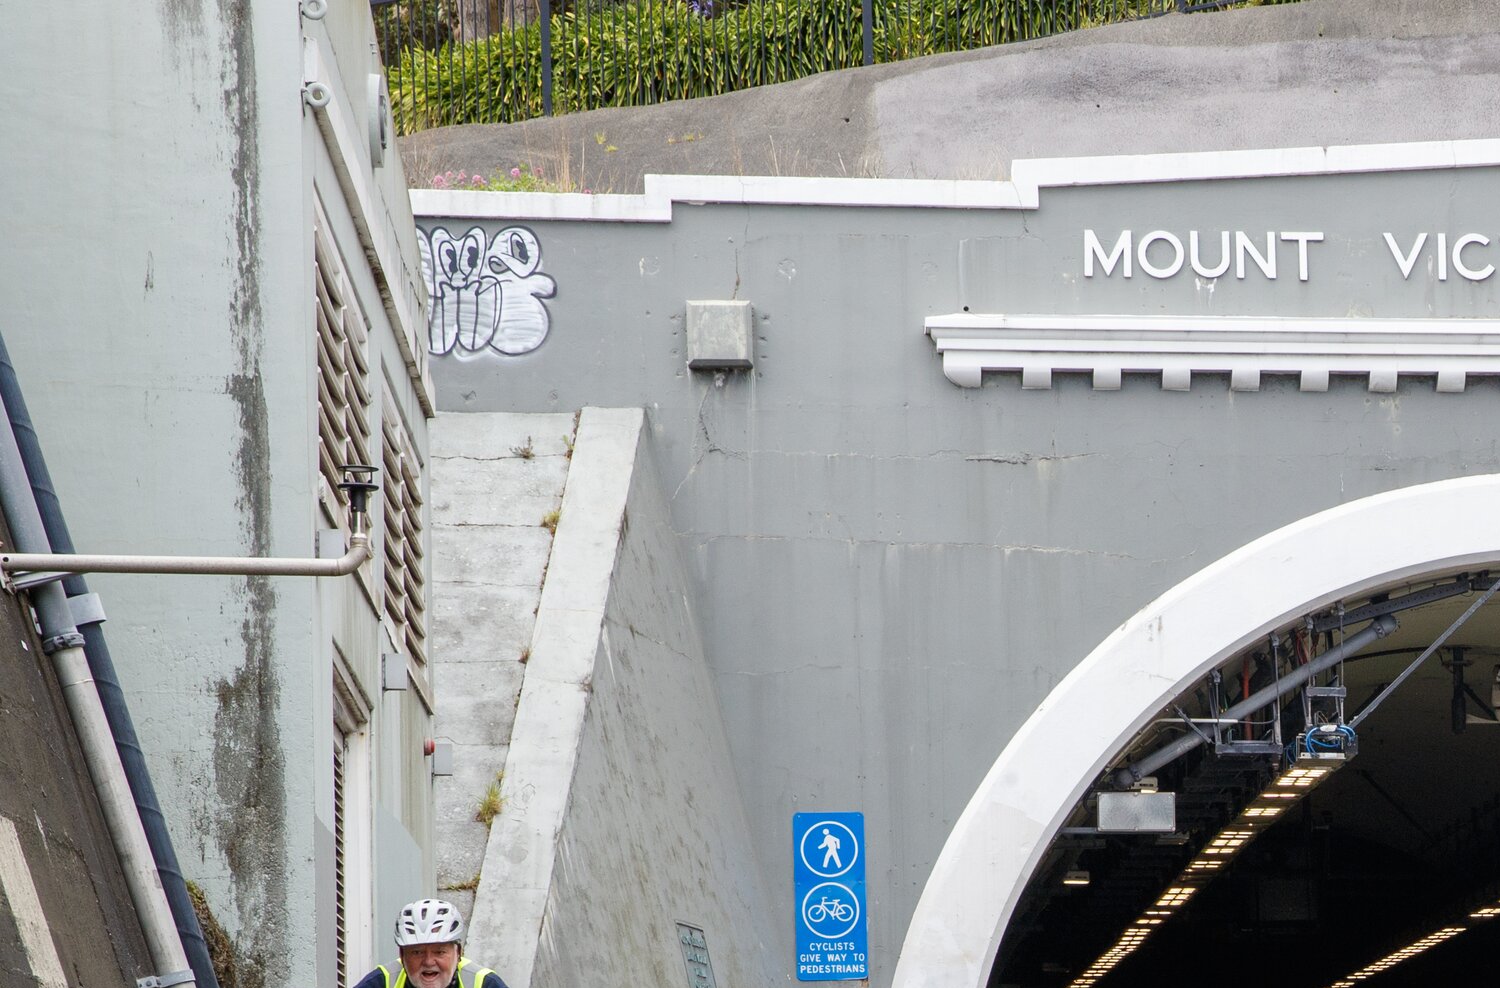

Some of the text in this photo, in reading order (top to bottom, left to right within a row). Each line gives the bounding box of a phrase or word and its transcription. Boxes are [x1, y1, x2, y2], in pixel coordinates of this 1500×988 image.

[1083, 229, 1325, 282] MOUNT
[809, 942, 855, 951] CYCLISTS
[800, 953, 865, 963] GIVE WAY TO
[800, 964, 865, 974] PEDESTRIANS
